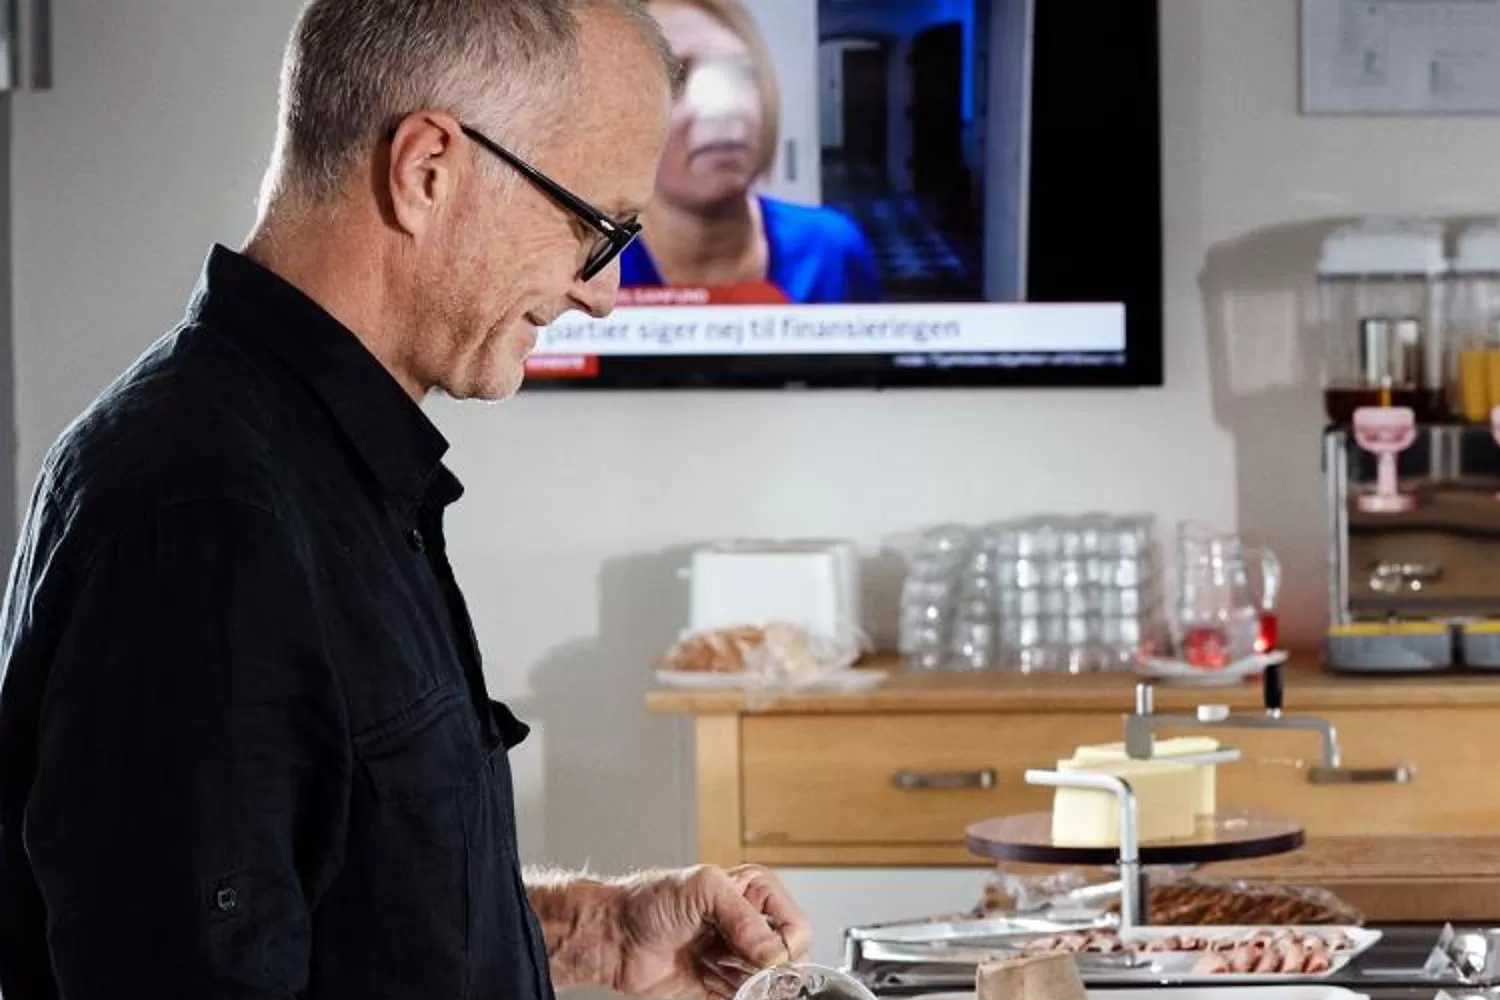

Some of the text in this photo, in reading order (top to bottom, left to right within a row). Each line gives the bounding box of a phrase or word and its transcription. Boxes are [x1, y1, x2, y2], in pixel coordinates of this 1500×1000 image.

[640, 320, 698, 344] siger
[704, 320, 746, 345] nej
[751, 316, 776, 338] til
[782, 315, 961, 343] finansieringen
